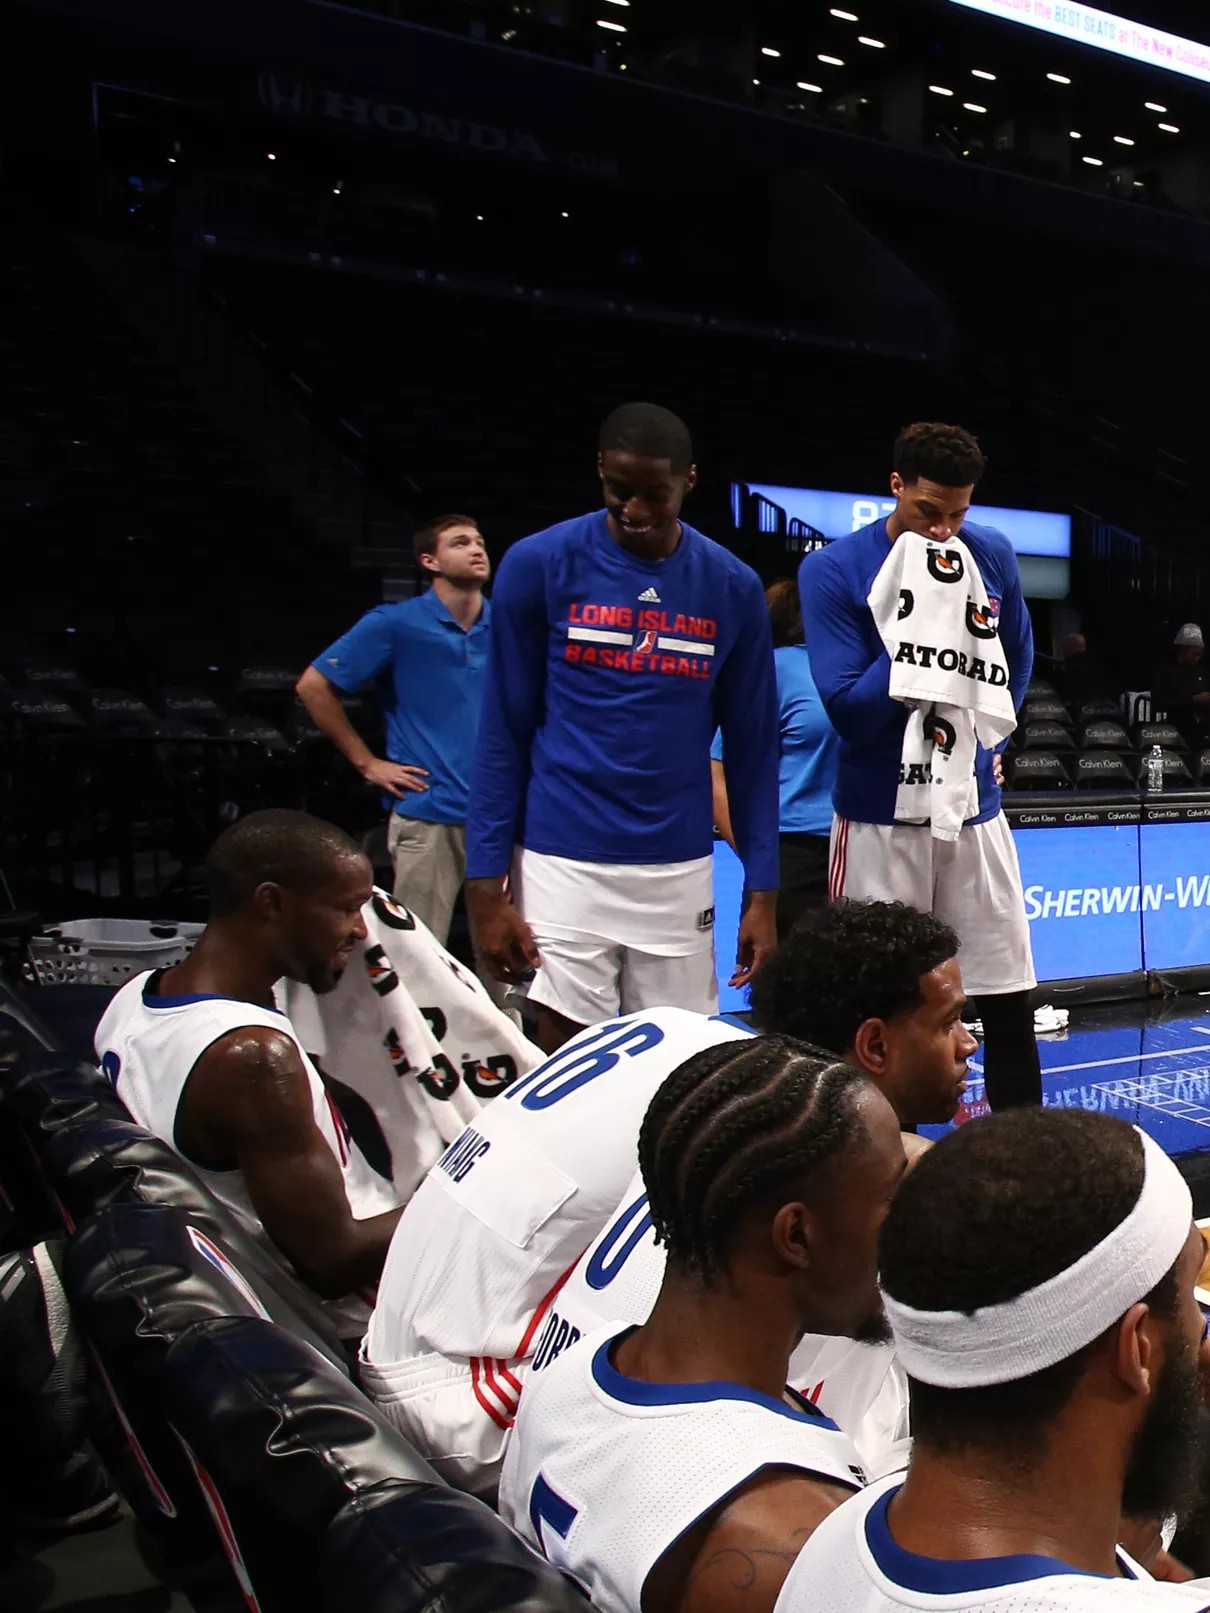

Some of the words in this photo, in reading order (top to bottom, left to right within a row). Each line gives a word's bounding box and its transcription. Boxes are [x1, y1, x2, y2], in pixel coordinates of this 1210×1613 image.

[1055, 5, 1080, 28] BEST
[1084, 15, 1116, 40] SEATS
[1152, 38, 1173, 57] New
[320, 89, 552, 163] HONDA
[569, 602, 634, 628] LONG
[637, 609, 718, 640] ISLAND
[564, 643, 712, 679] BASKETBALL
[1020, 814, 1040, 823] Calvin
[1041, 814, 1056, 823] Klein
[1064, 813, 1083, 822] Calvin
[1084, 813, 1099, 821] Klein
[1107, 811, 1126, 820] Calvin
[1126, 812, 1141, 820] Klein
[1148, 811, 1166, 819] Calvin
[1187, 809, 1203, 817] Calvin
[504, 1019, 665, 1111] 16
